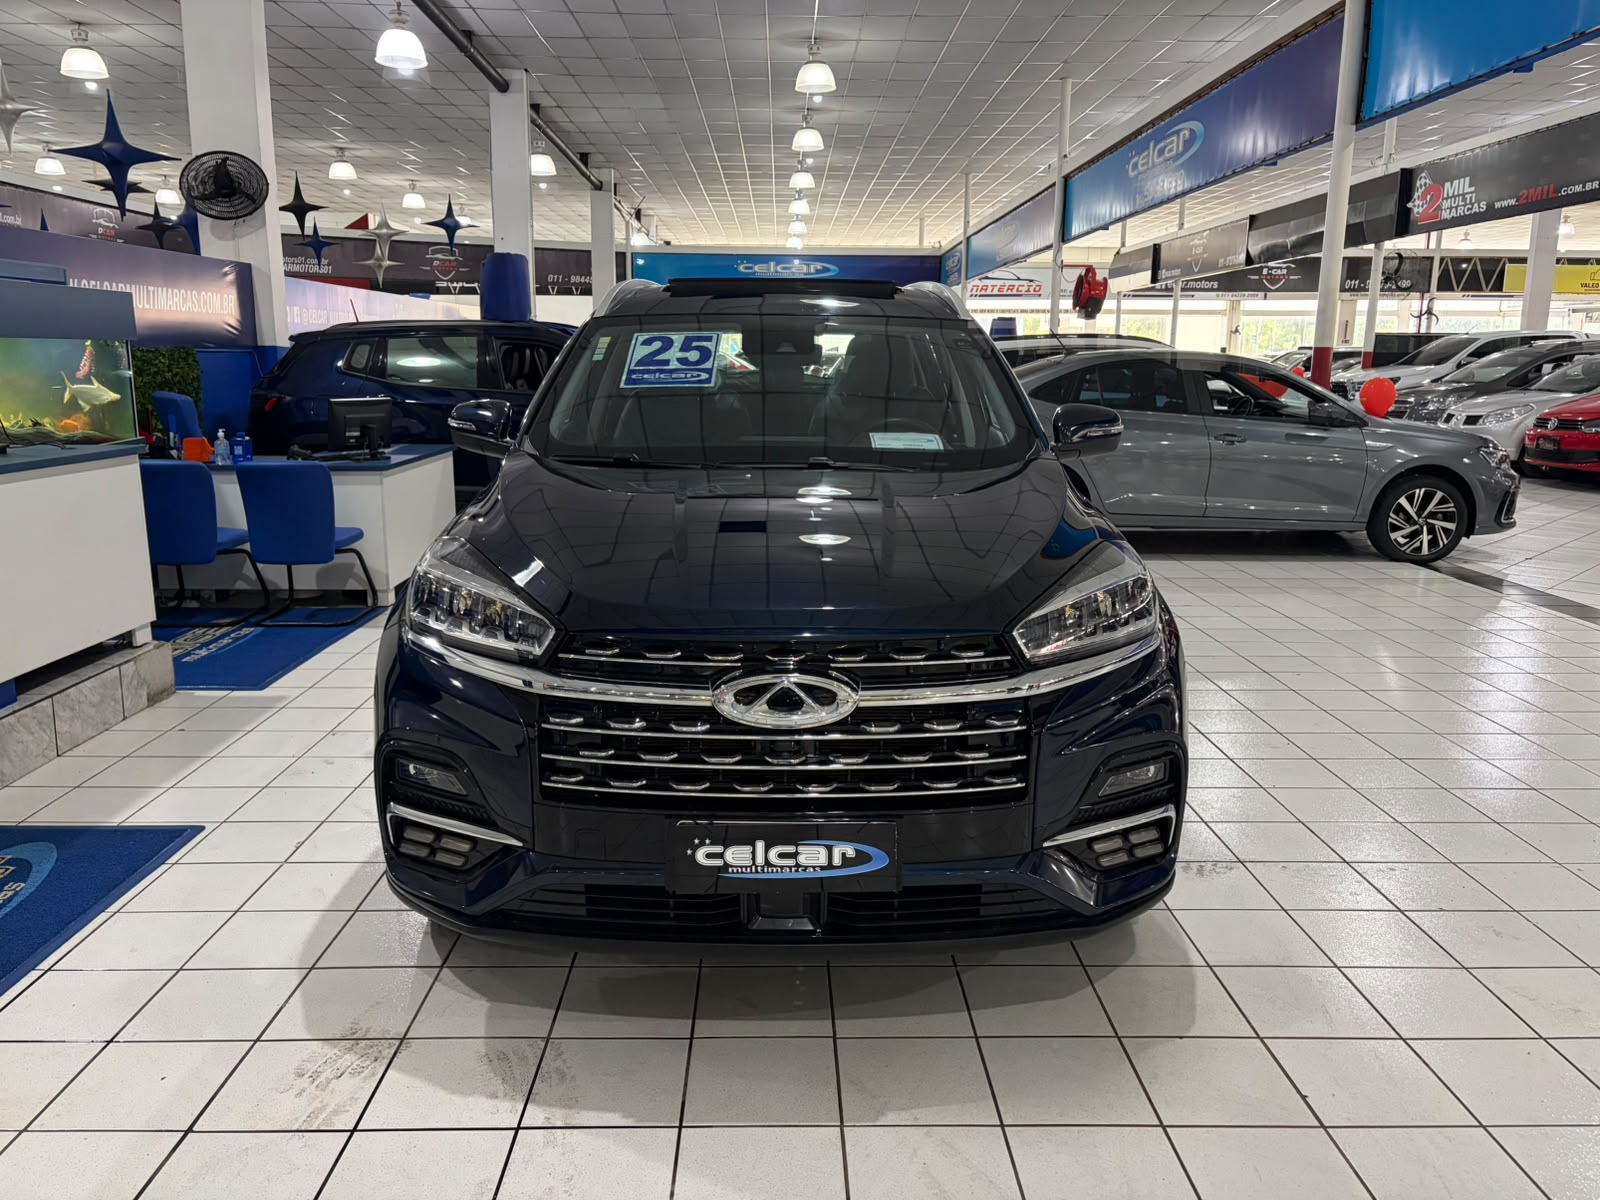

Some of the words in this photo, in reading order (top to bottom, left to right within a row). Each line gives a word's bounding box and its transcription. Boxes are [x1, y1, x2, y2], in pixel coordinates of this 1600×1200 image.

[1127, 127, 1191, 178] celcar
[1418, 183, 1444, 225] 2
[1443, 176, 1475, 198] MIL
[1442, 193, 1476, 210] MULTI
[1494, 180, 1600, 210] www.2MIL.COM.BR
[1441, 201, 1487, 221] MARCAS
[737, 261, 824, 274] celcar
[548, 274, 562, 283] 011
[1345, 280, 1359, 288] 011
[634, 335, 714, 367] 25
[631, 372, 699, 380] celcar
[694, 840, 856, 866] celcar
